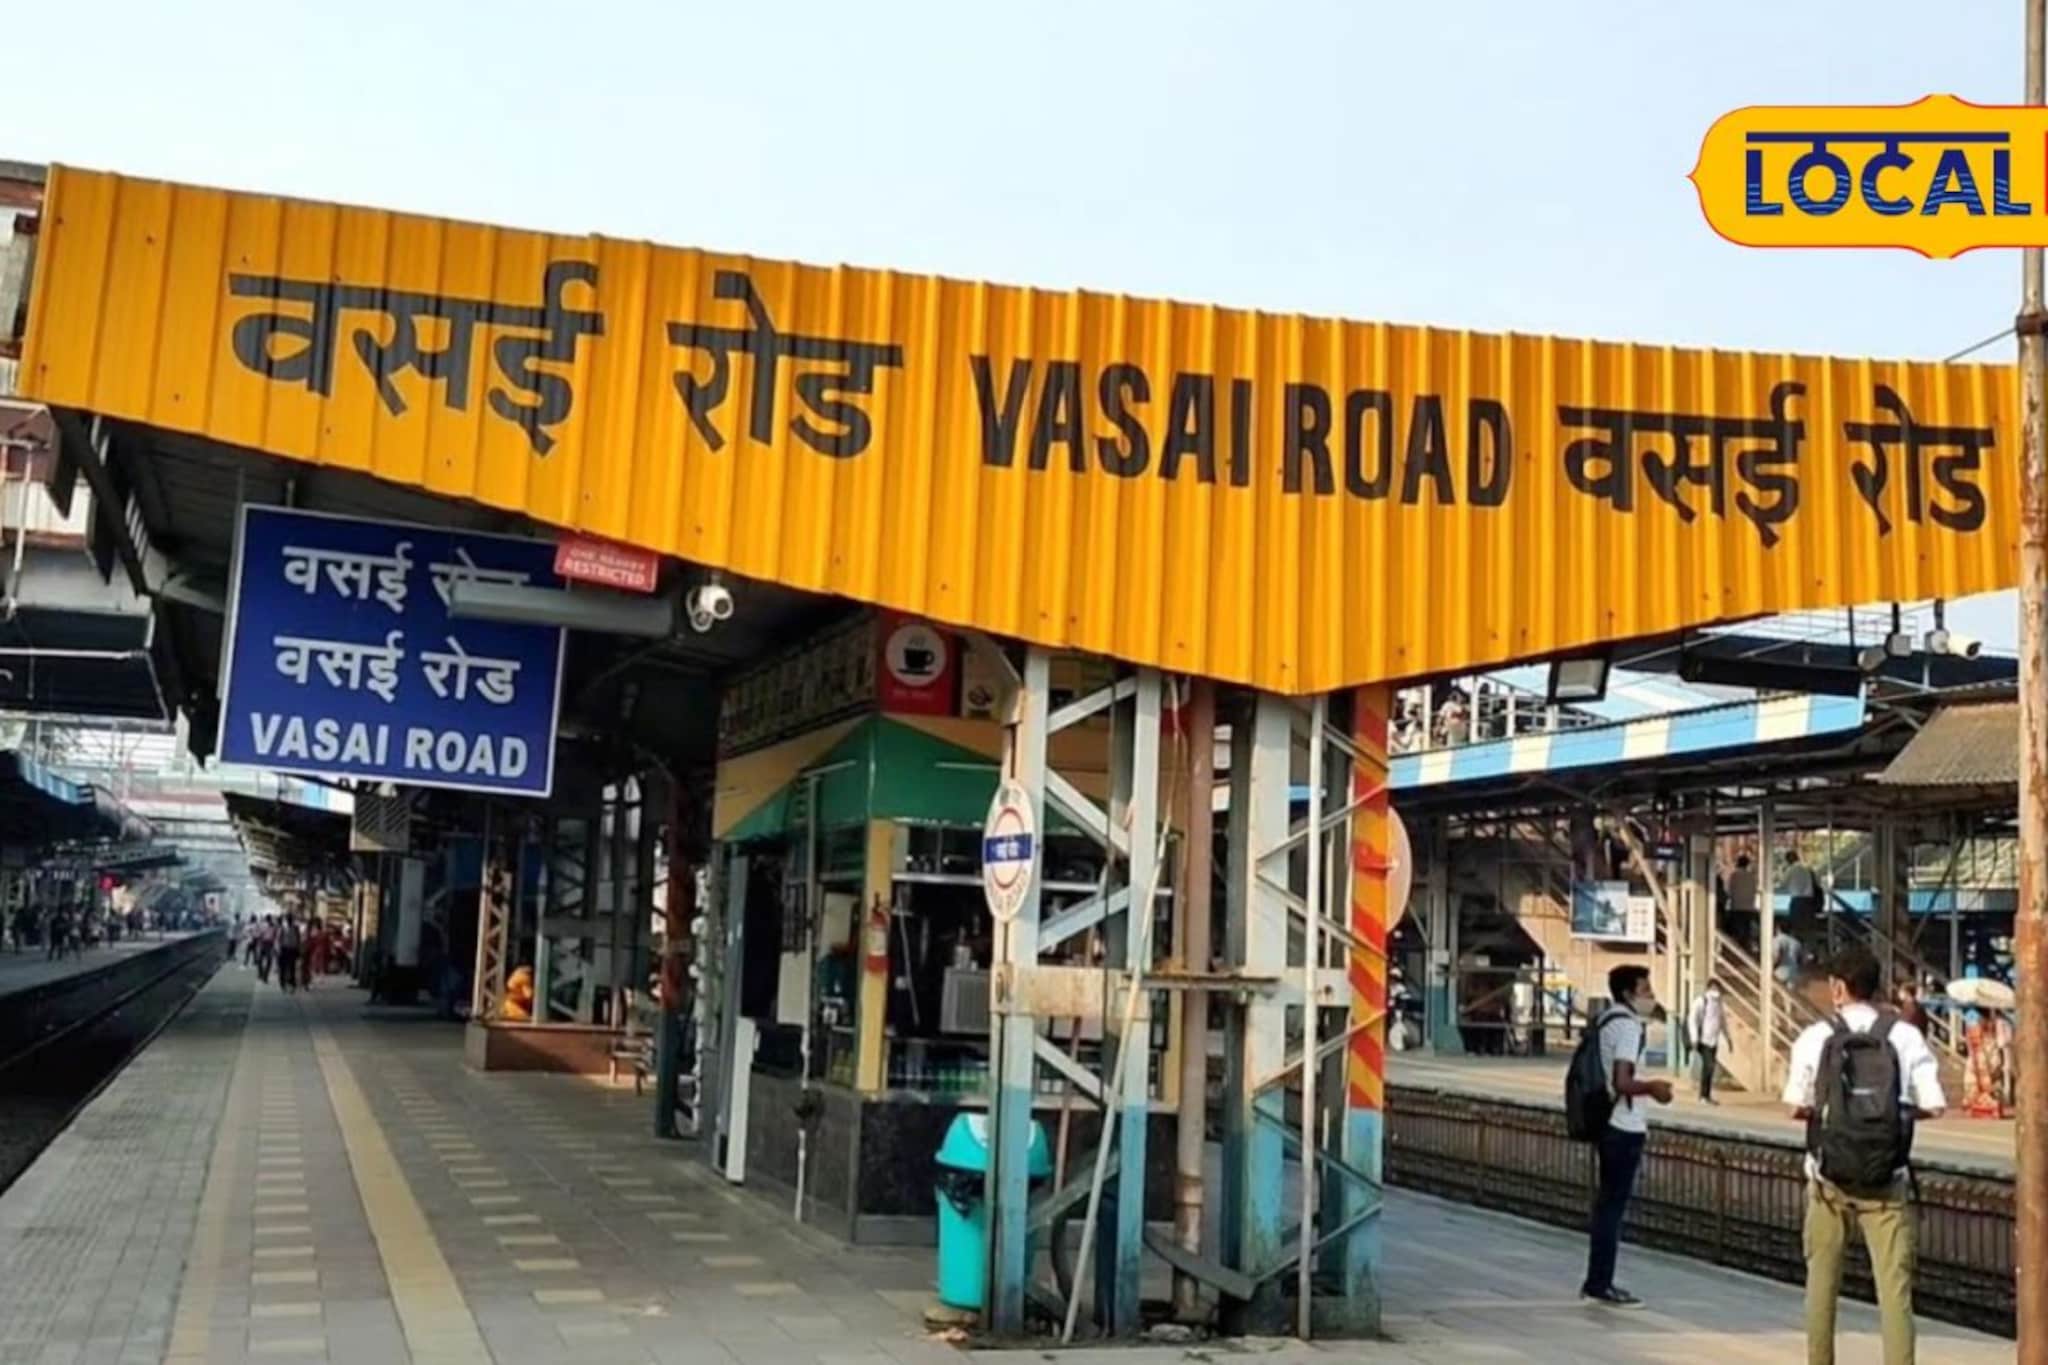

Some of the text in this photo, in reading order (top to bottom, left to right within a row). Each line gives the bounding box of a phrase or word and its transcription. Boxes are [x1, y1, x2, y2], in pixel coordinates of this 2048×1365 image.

[228, 260, 904, 459] वसई रोड
[969, 353, 1513, 508] VASAI ROAD
[1558, 381, 1995, 549] वसई रोड
[282, 542, 414, 614] वसई
[273, 631, 521, 704] वसई रोड
[250, 713, 529, 778] VASAI ROAD
